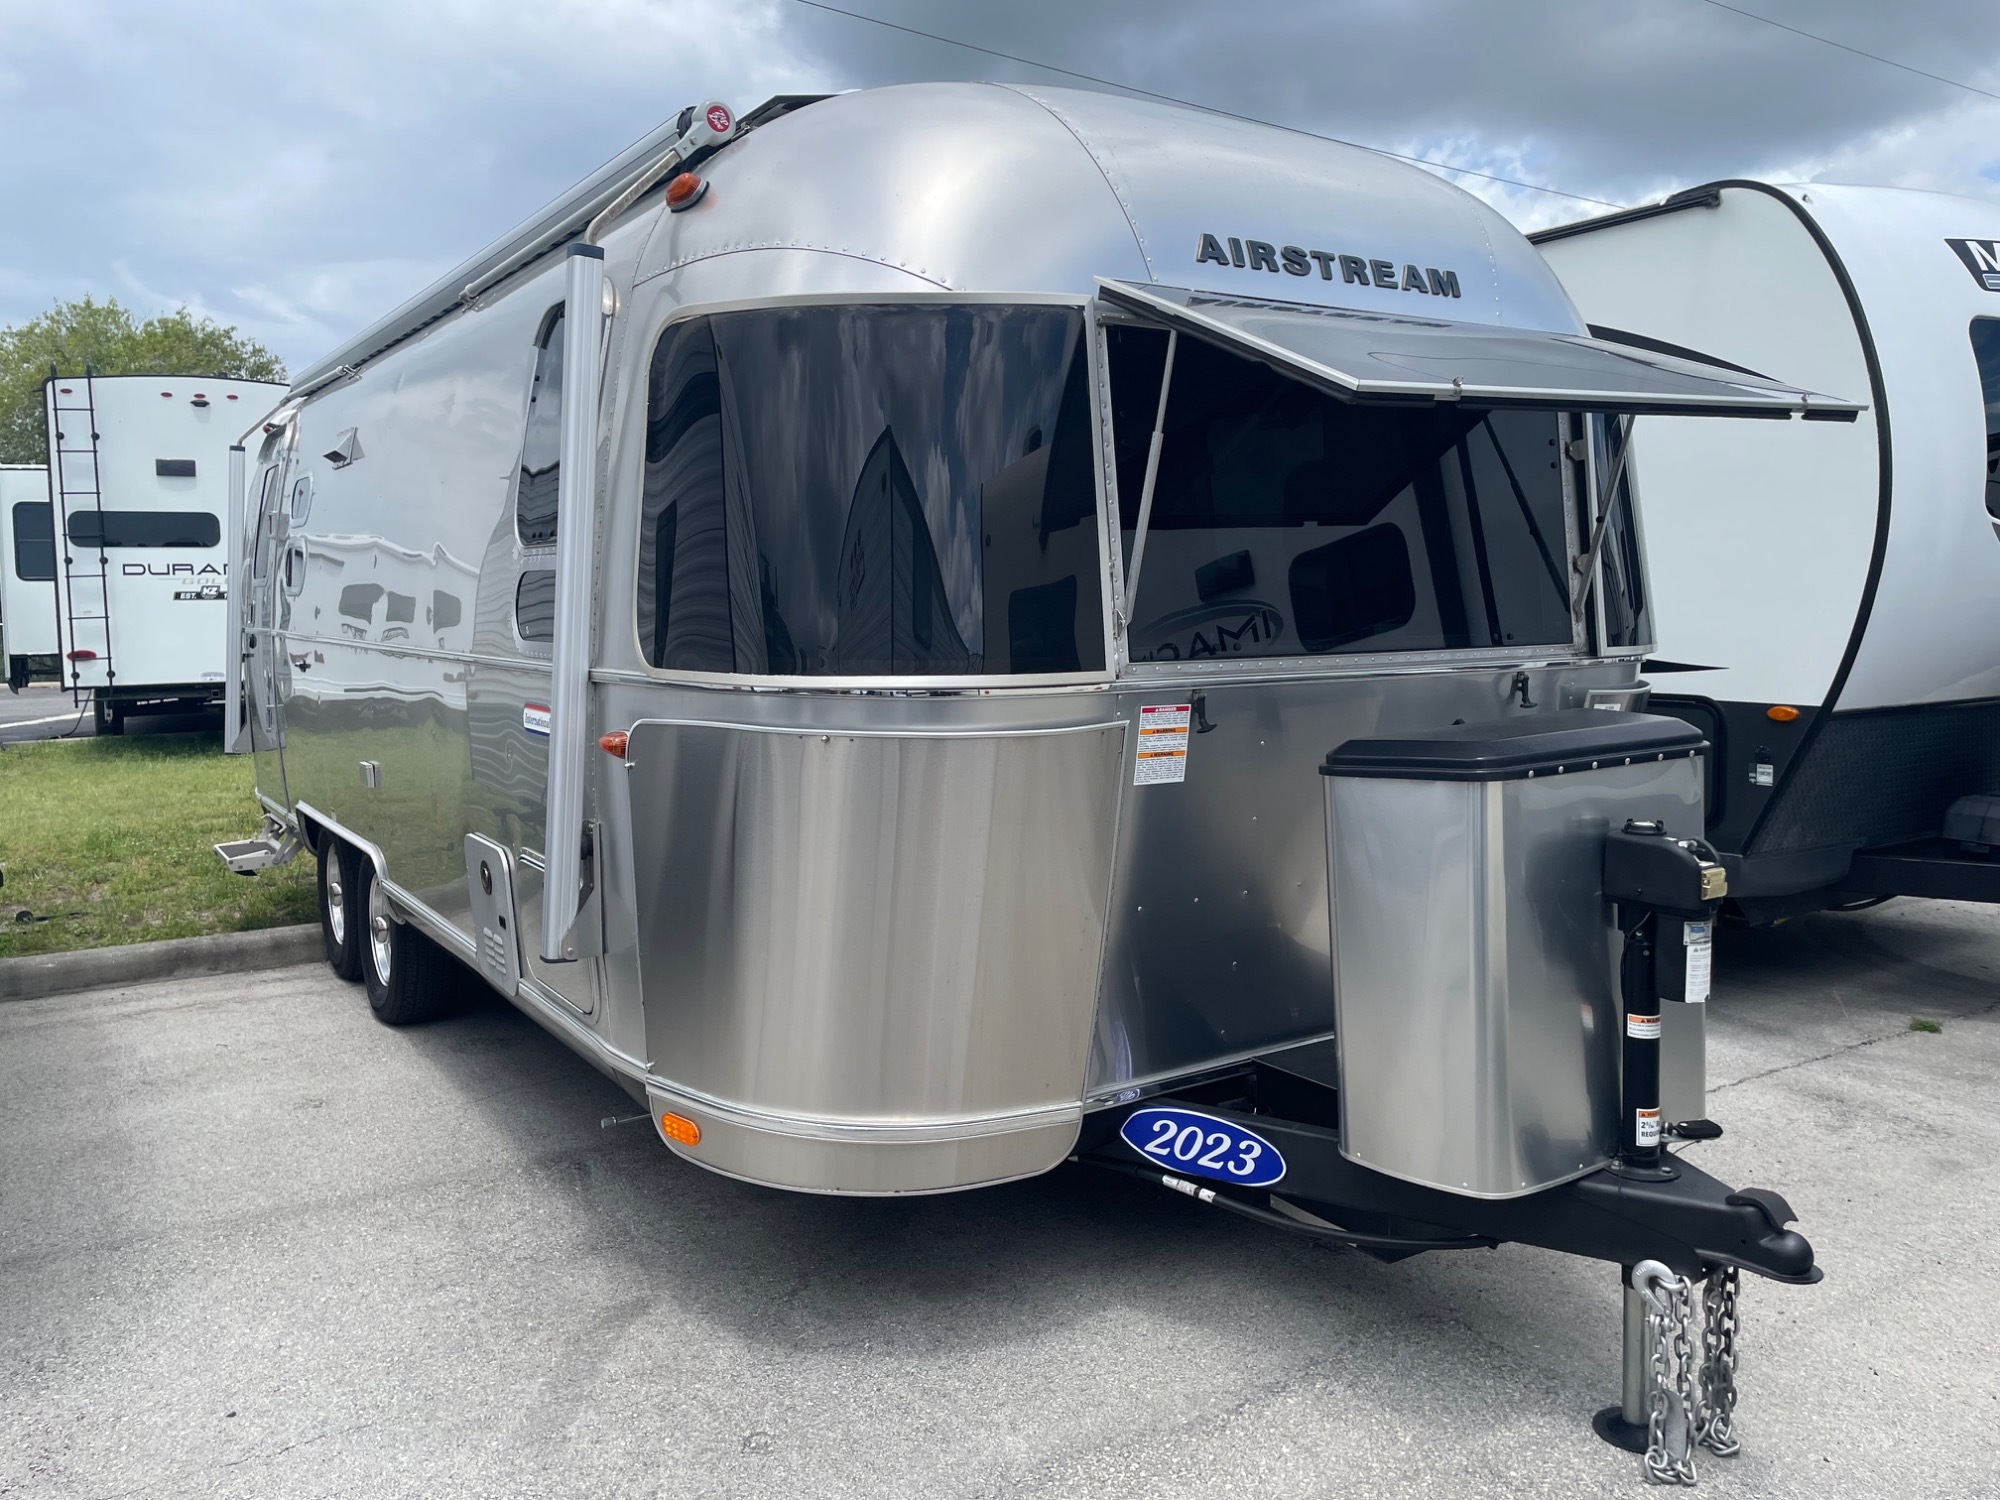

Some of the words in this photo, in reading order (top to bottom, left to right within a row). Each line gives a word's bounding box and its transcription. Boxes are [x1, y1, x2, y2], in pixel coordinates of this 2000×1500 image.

[1196, 232, 1462, 299] AIRSTREAM
[182, 577, 228, 585] GOL
[202, 586, 218, 595] KZ
[1144, 1119, 1262, 1176] 2023
